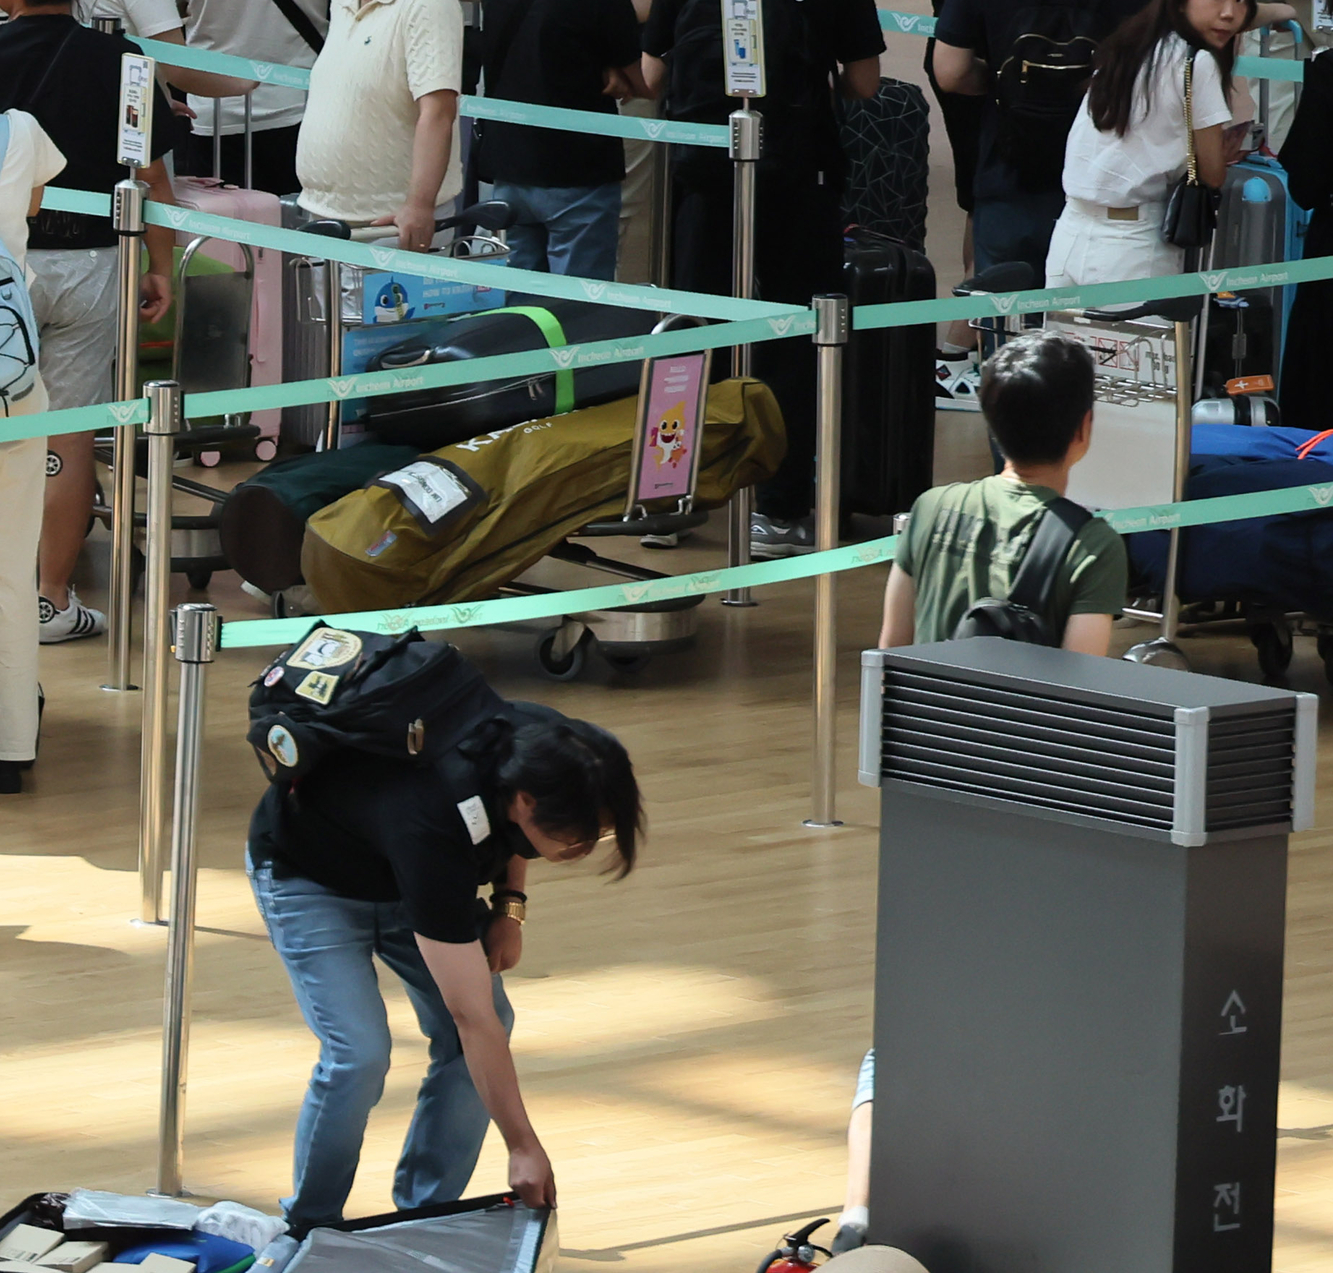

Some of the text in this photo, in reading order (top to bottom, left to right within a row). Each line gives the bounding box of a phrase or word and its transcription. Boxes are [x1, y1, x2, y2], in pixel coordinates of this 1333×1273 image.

[1226, 273, 1288, 287] Incheon Airport
[1017, 296, 1080, 310] Incheon Airport
[1212, 989, 1247, 1231] 소화전
